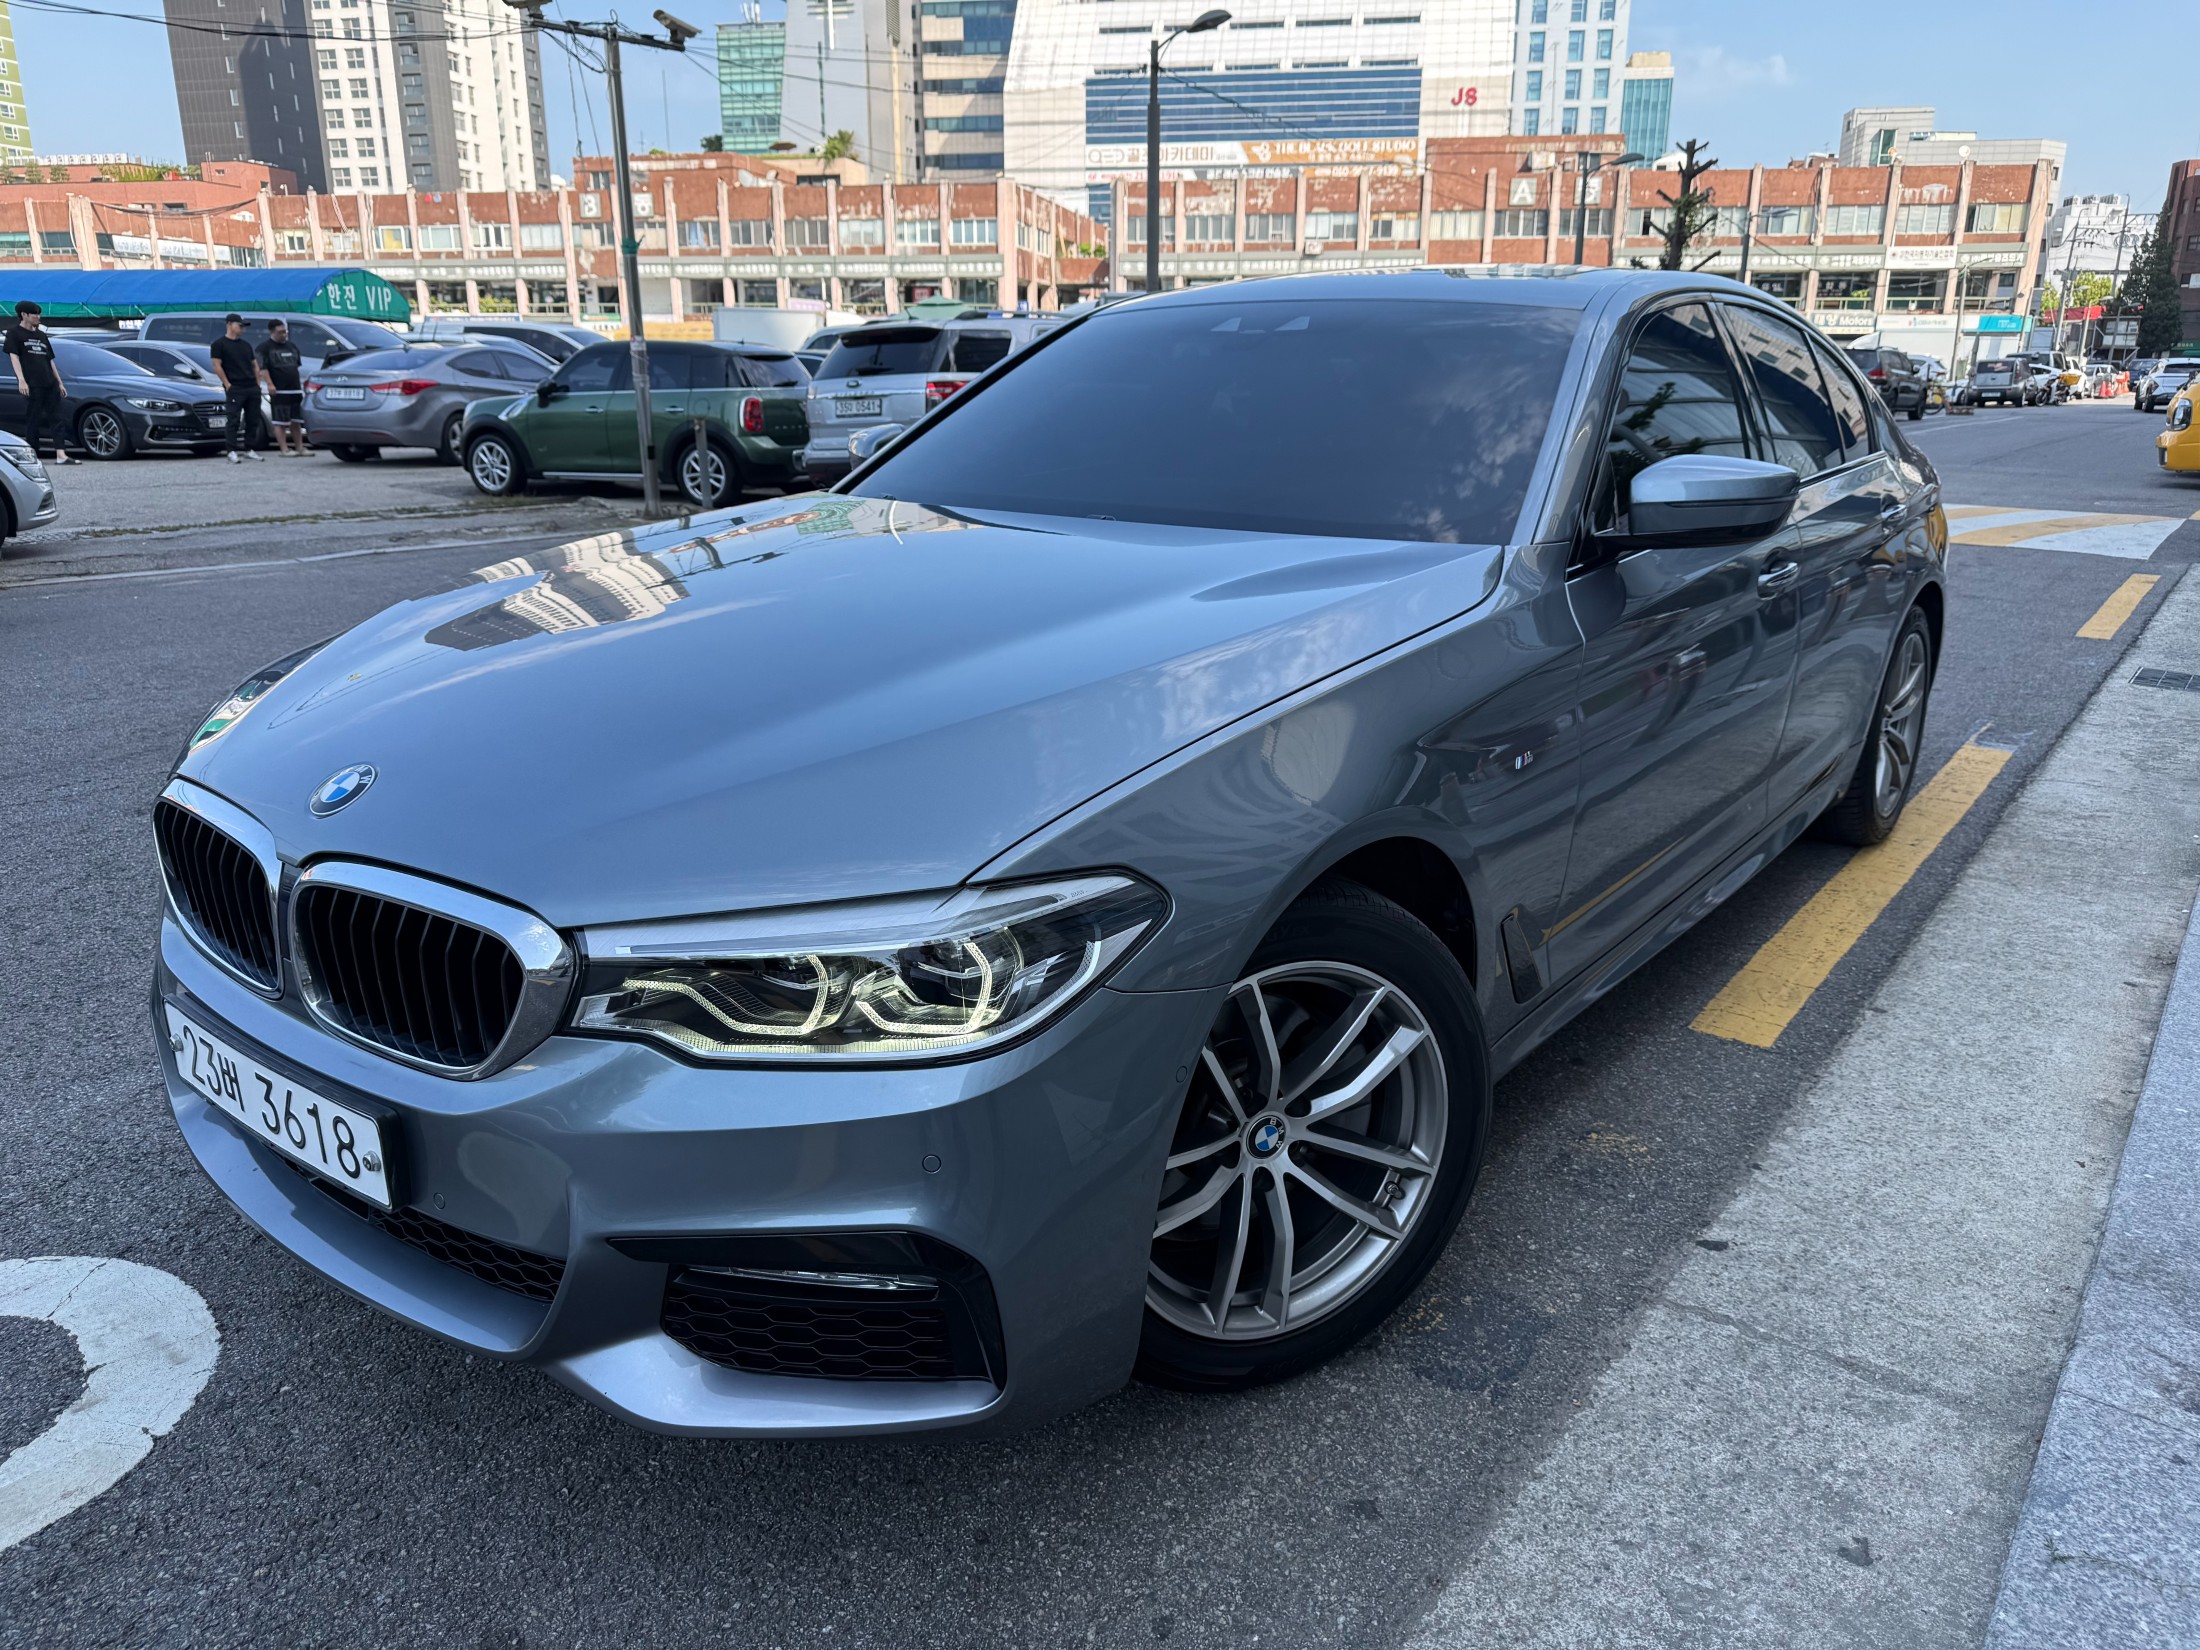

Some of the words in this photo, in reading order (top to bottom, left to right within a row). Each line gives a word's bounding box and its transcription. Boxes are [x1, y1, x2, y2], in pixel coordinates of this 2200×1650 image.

[1512, 178, 1533, 204] A
[582, 194, 598, 216] B
[326, 283, 357, 310] 한진
[365, 285, 392, 311] VIP
[1839, 315, 1873, 326] Motors
[183, 1025, 245, 1112] 23버
[254, 1071, 361, 1179] 3618
